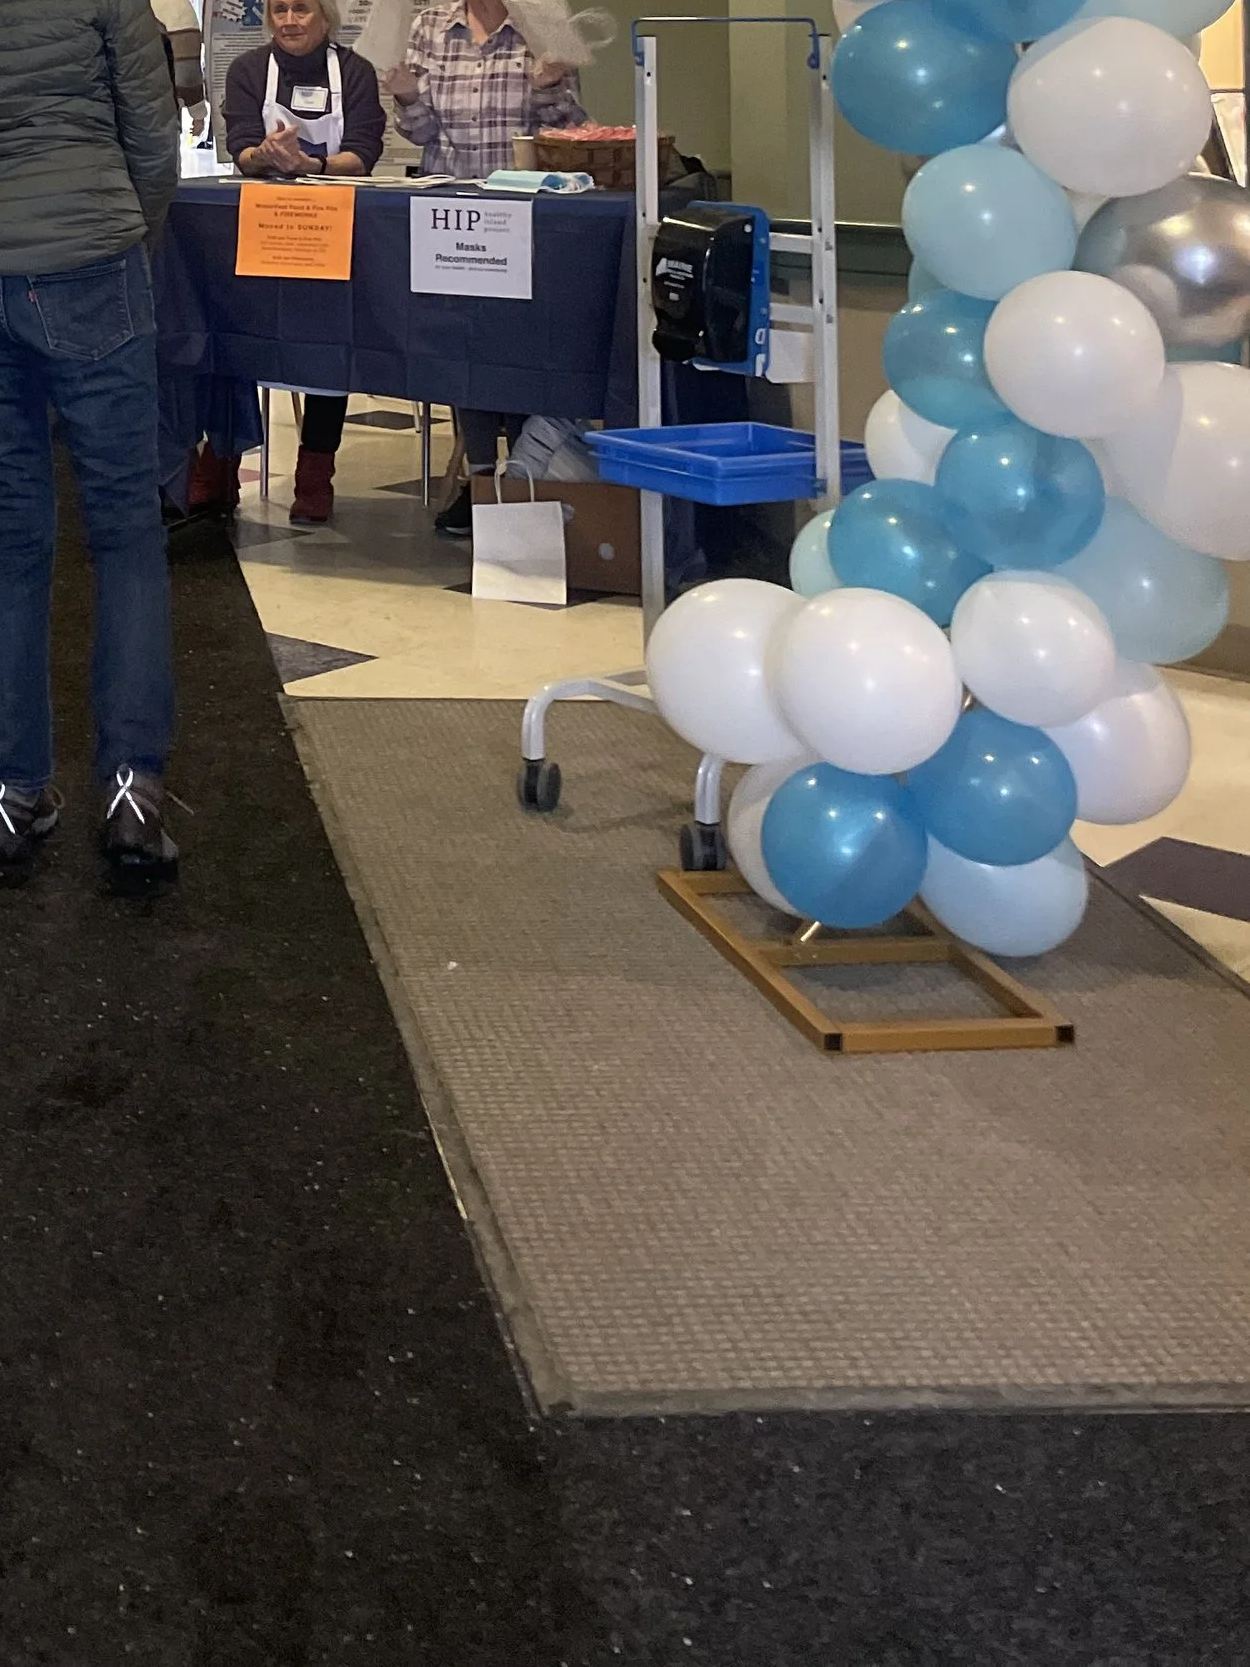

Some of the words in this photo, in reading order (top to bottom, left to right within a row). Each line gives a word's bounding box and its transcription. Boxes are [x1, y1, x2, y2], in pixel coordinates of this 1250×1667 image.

[431, 208, 481, 231] HIP
[455, 242, 487, 252] Masks
[435, 253, 508, 266] Recommended
